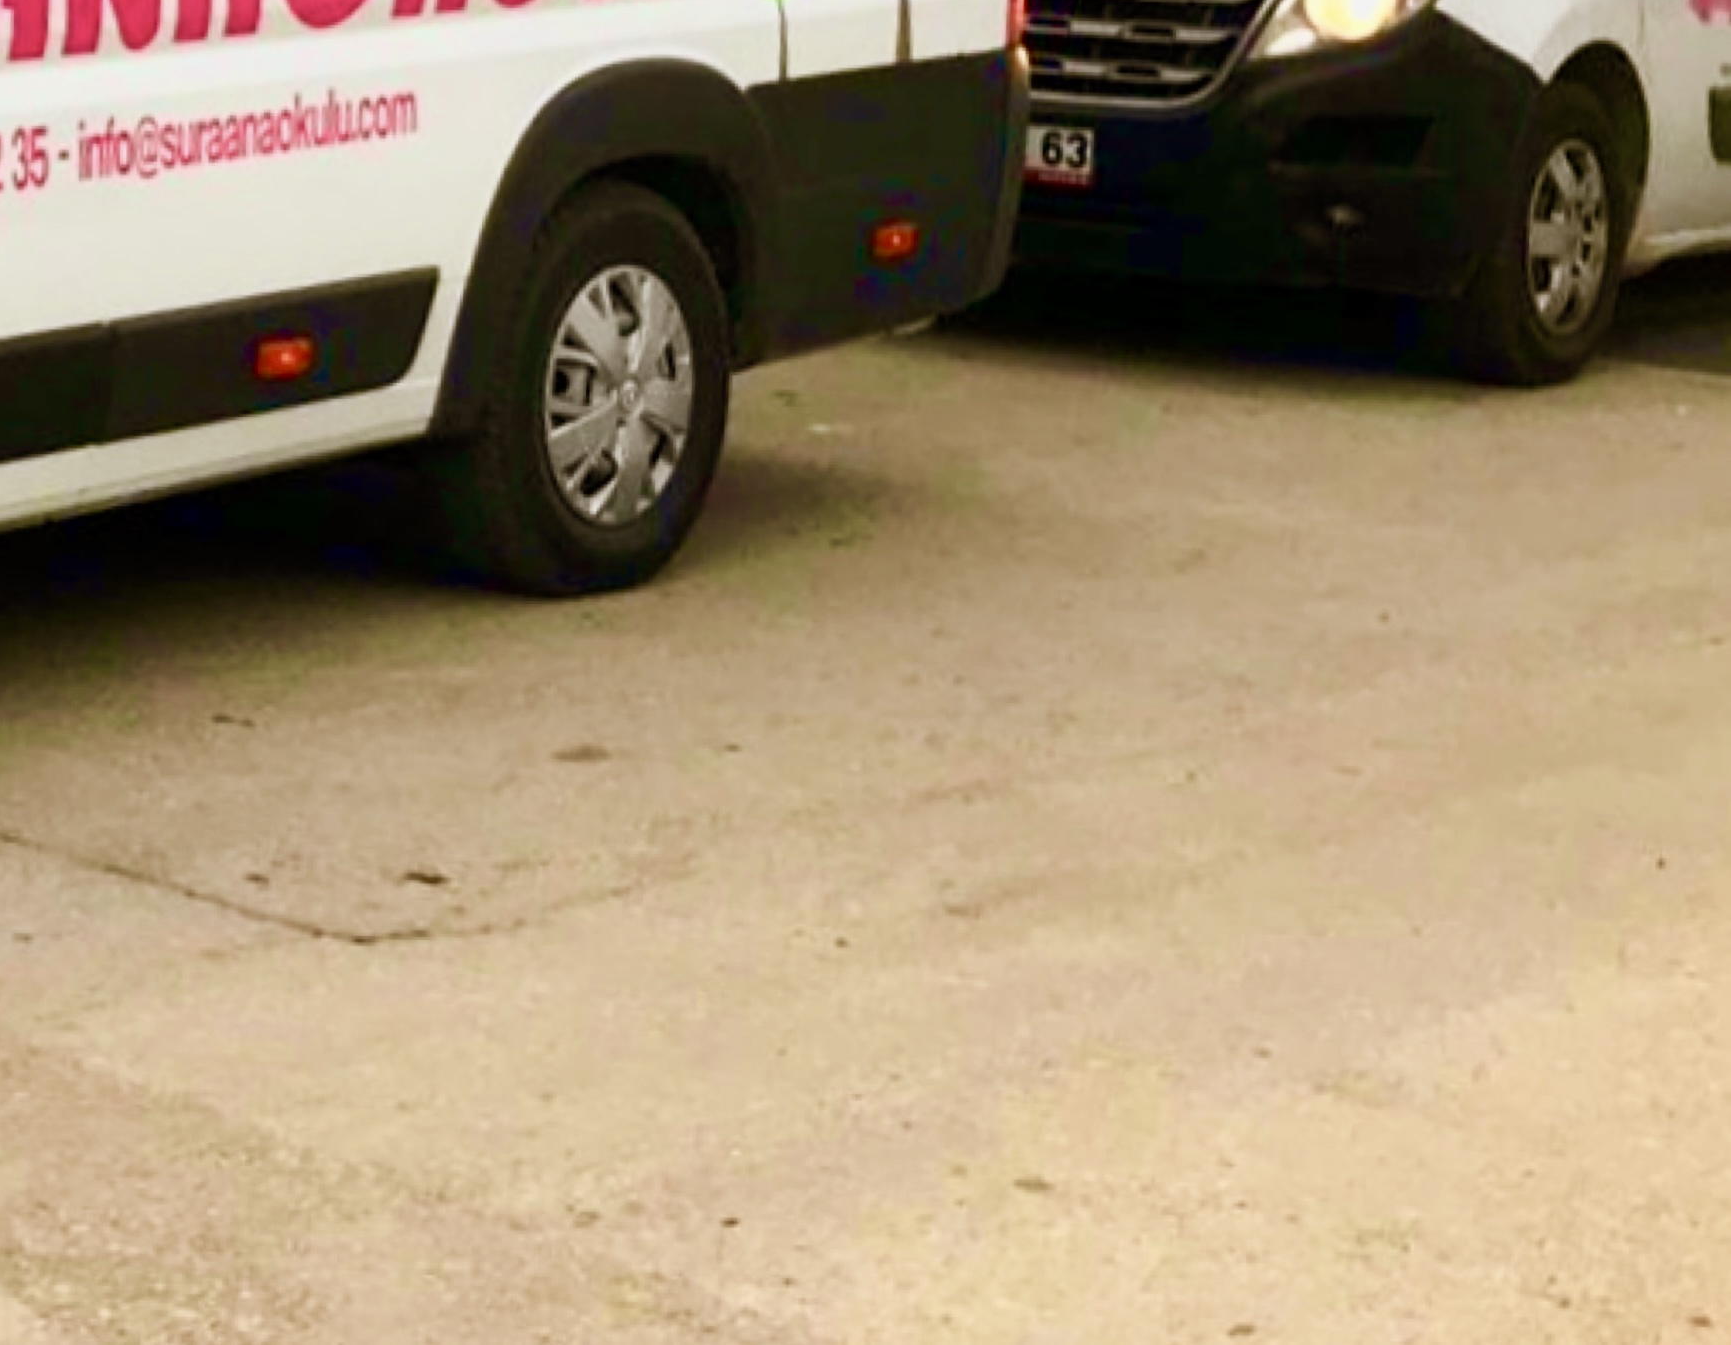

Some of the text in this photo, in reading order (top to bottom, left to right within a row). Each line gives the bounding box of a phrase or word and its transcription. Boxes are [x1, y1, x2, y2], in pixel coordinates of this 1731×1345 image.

[12, 125, 50, 193] 35
[77, 88, 419, 181] info@suraanaokulu.com
[1041, 132, 1088, 168] 63
